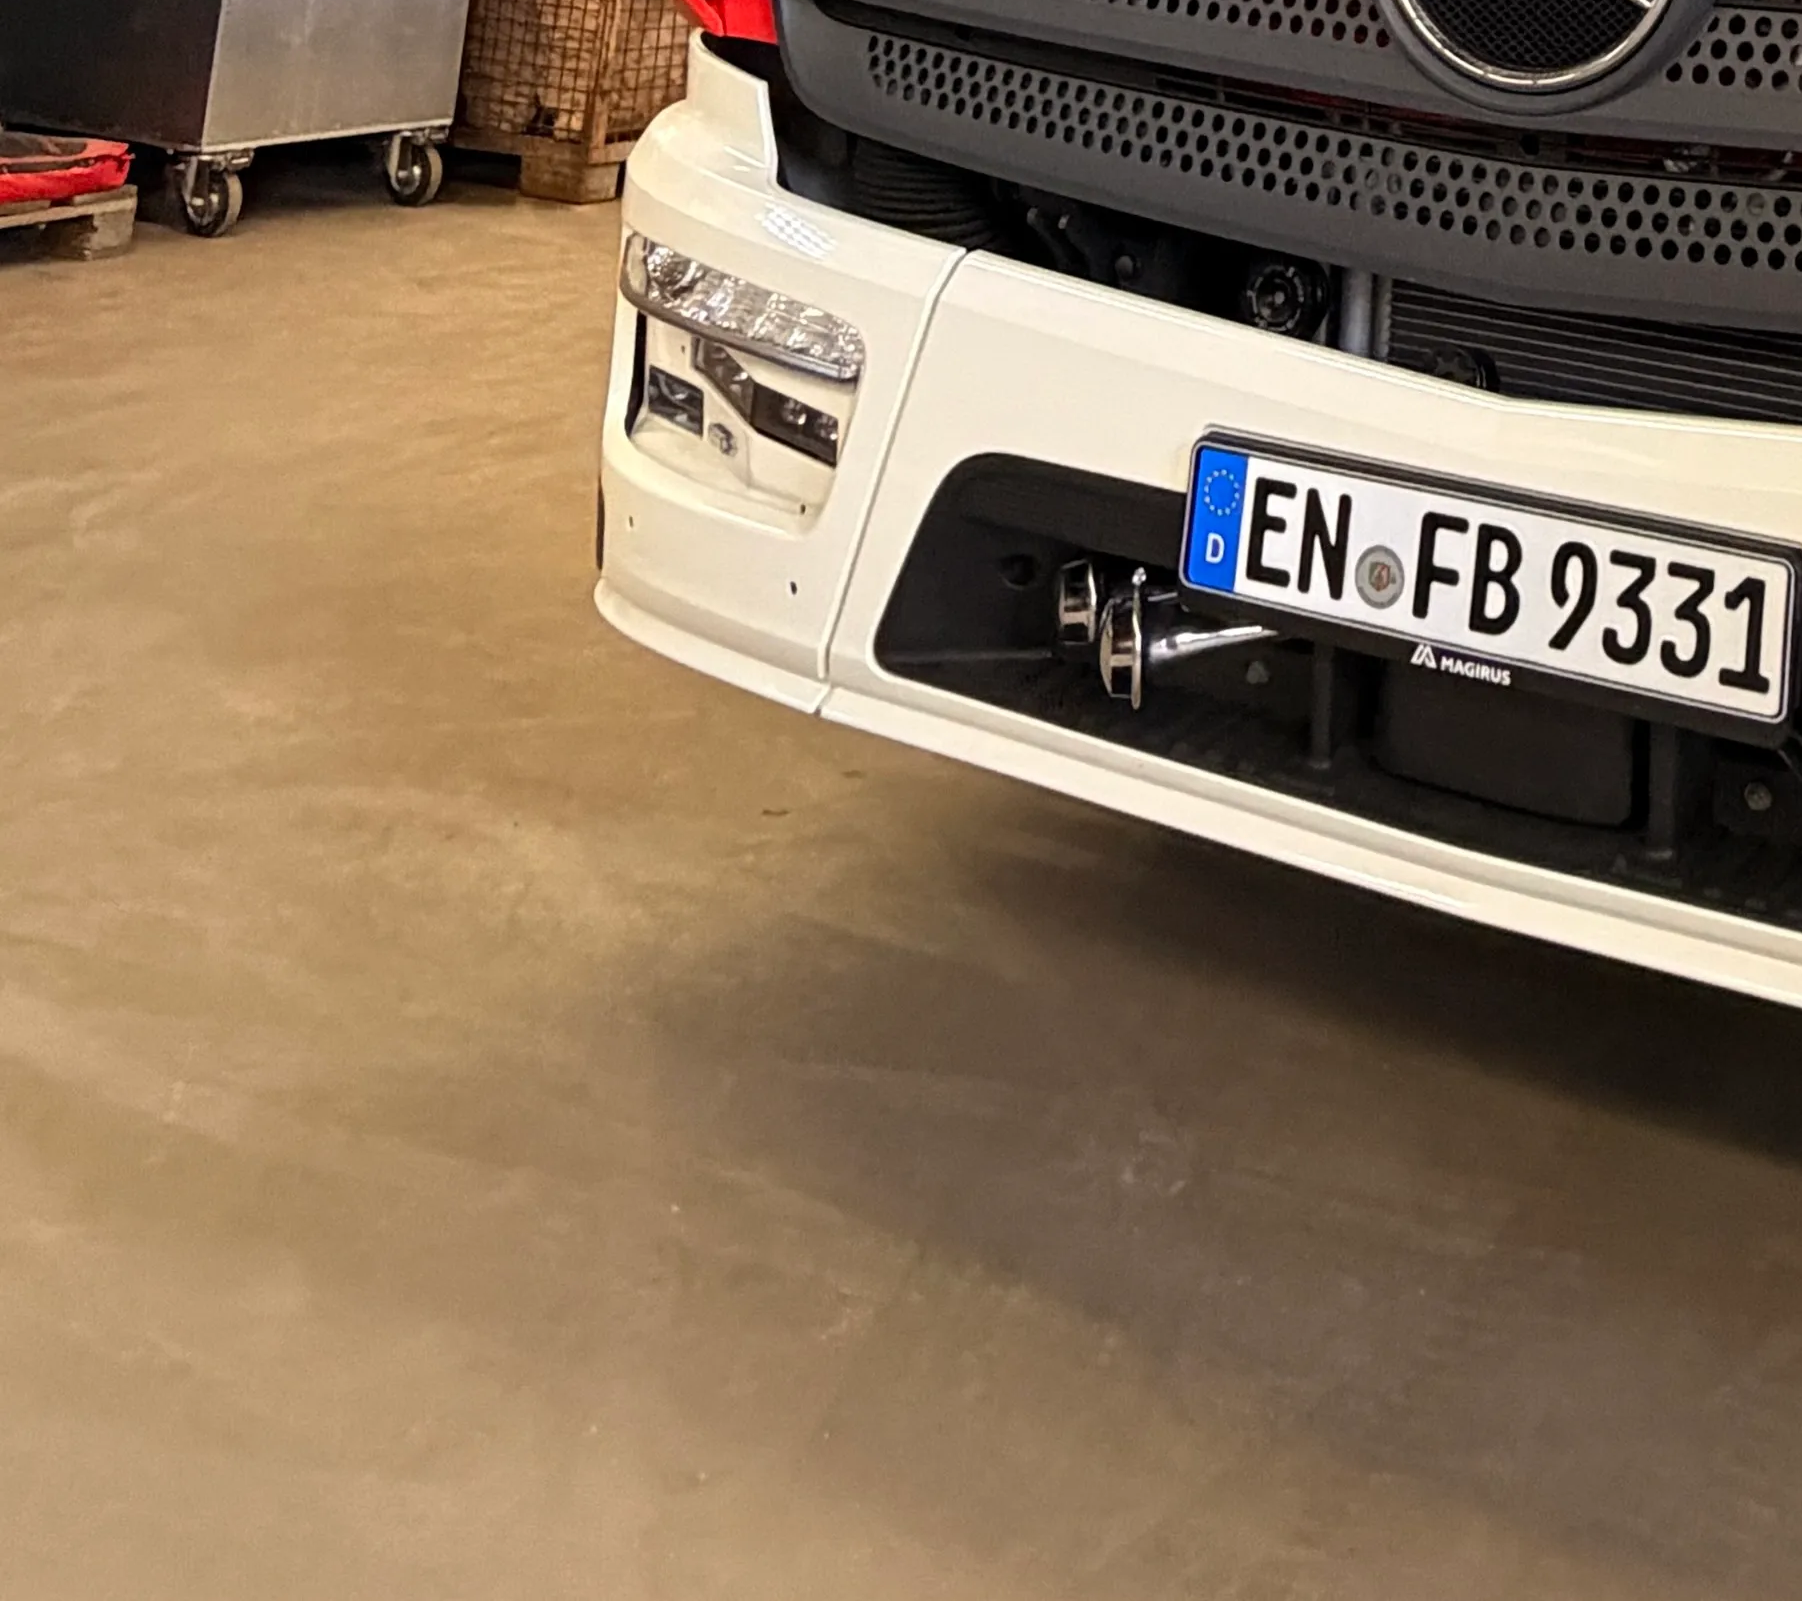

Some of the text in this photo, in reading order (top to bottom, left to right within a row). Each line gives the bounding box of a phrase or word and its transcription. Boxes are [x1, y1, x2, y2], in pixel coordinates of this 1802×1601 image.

[1204, 531, 1226, 565] D
[1243, 475, 1772, 696] EN FB 9331
[1439, 655, 1512, 687] MAGIRUS
